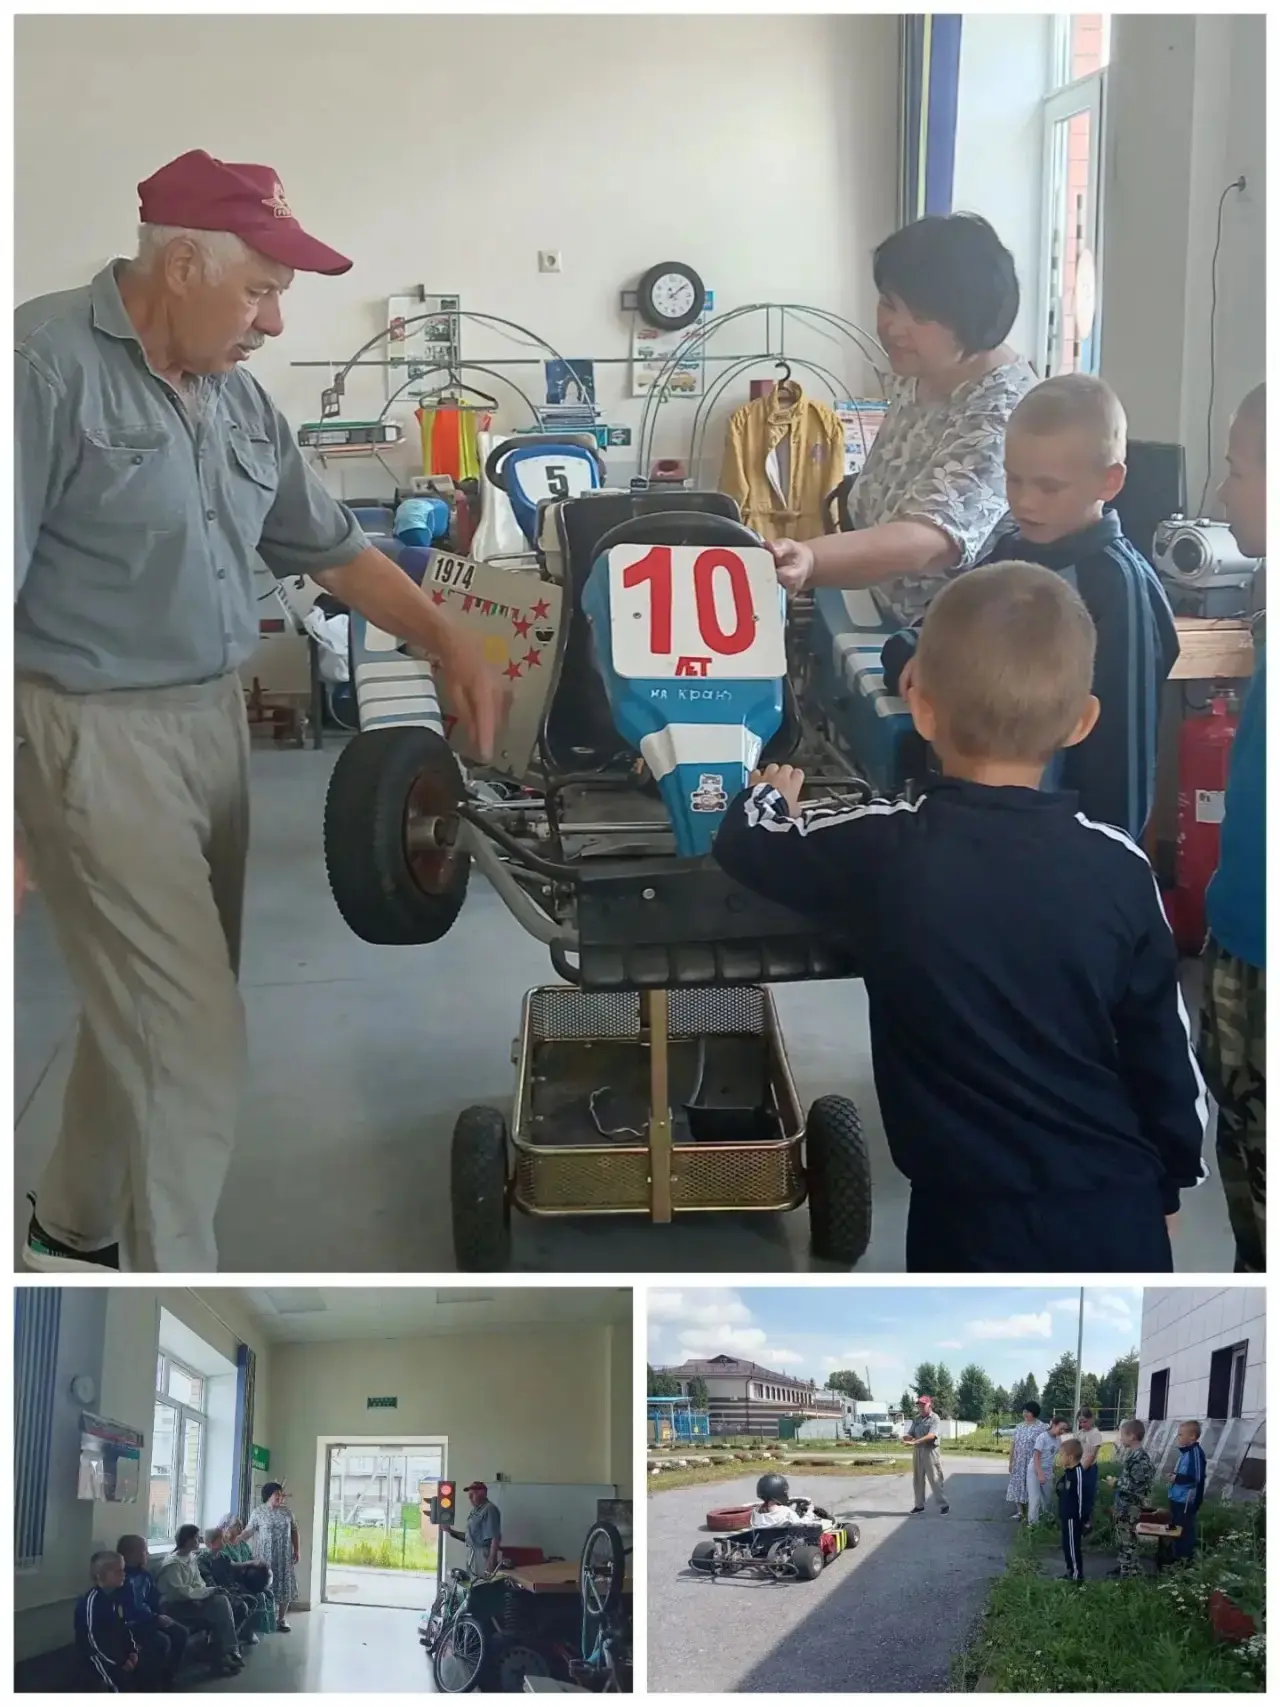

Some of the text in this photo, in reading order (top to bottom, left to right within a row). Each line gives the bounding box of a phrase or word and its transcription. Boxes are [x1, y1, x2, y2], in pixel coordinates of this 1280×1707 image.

[545, 466, 569, 499] 5
[434, 558, 475, 589] 1974
[623, 546, 756, 655] 10
